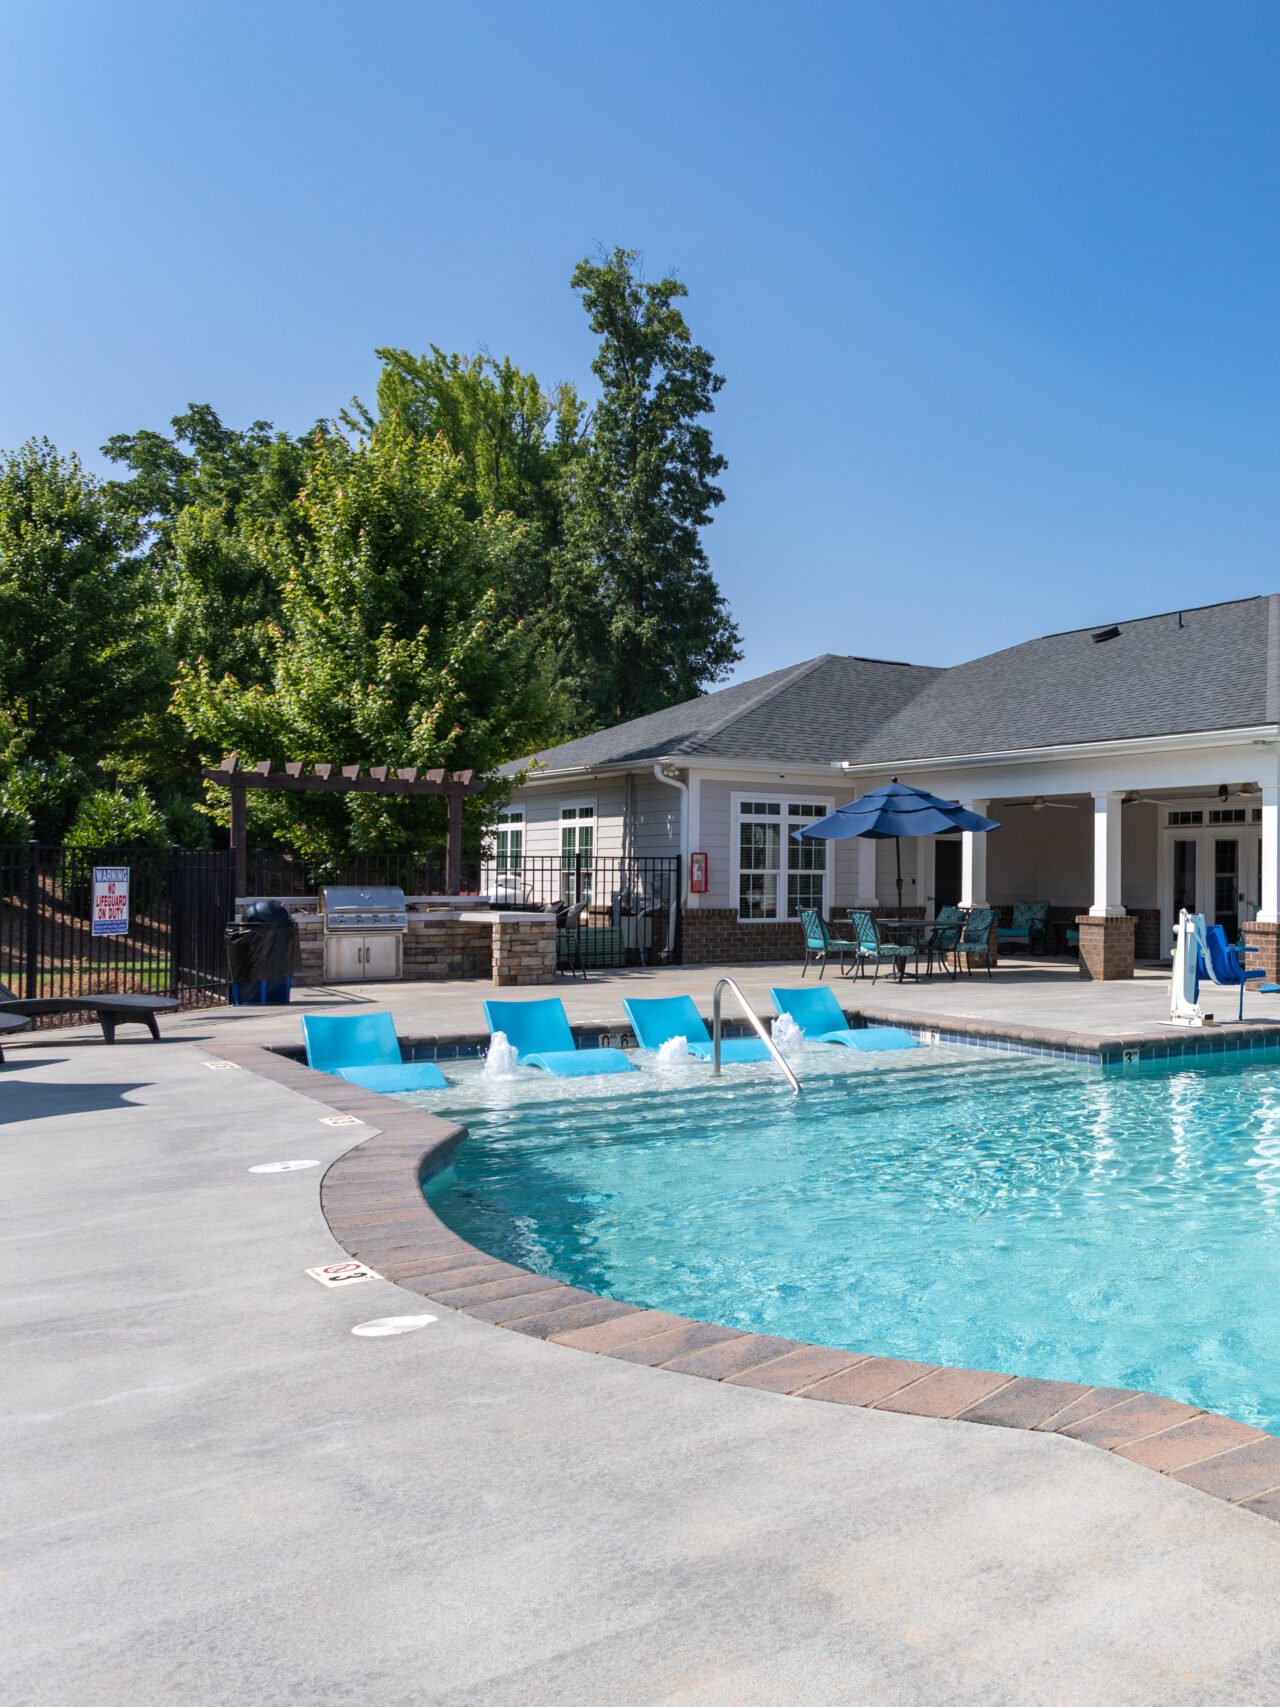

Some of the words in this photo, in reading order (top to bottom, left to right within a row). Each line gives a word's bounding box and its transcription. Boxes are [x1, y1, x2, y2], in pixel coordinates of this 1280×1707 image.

[95, 869, 128, 882] WARNING
[107, 883, 116, 894] NO
[96, 895, 127, 907] LIFEGUARD
[98, 908, 106, 919] ON
[108, 907, 123, 919] DUTY
